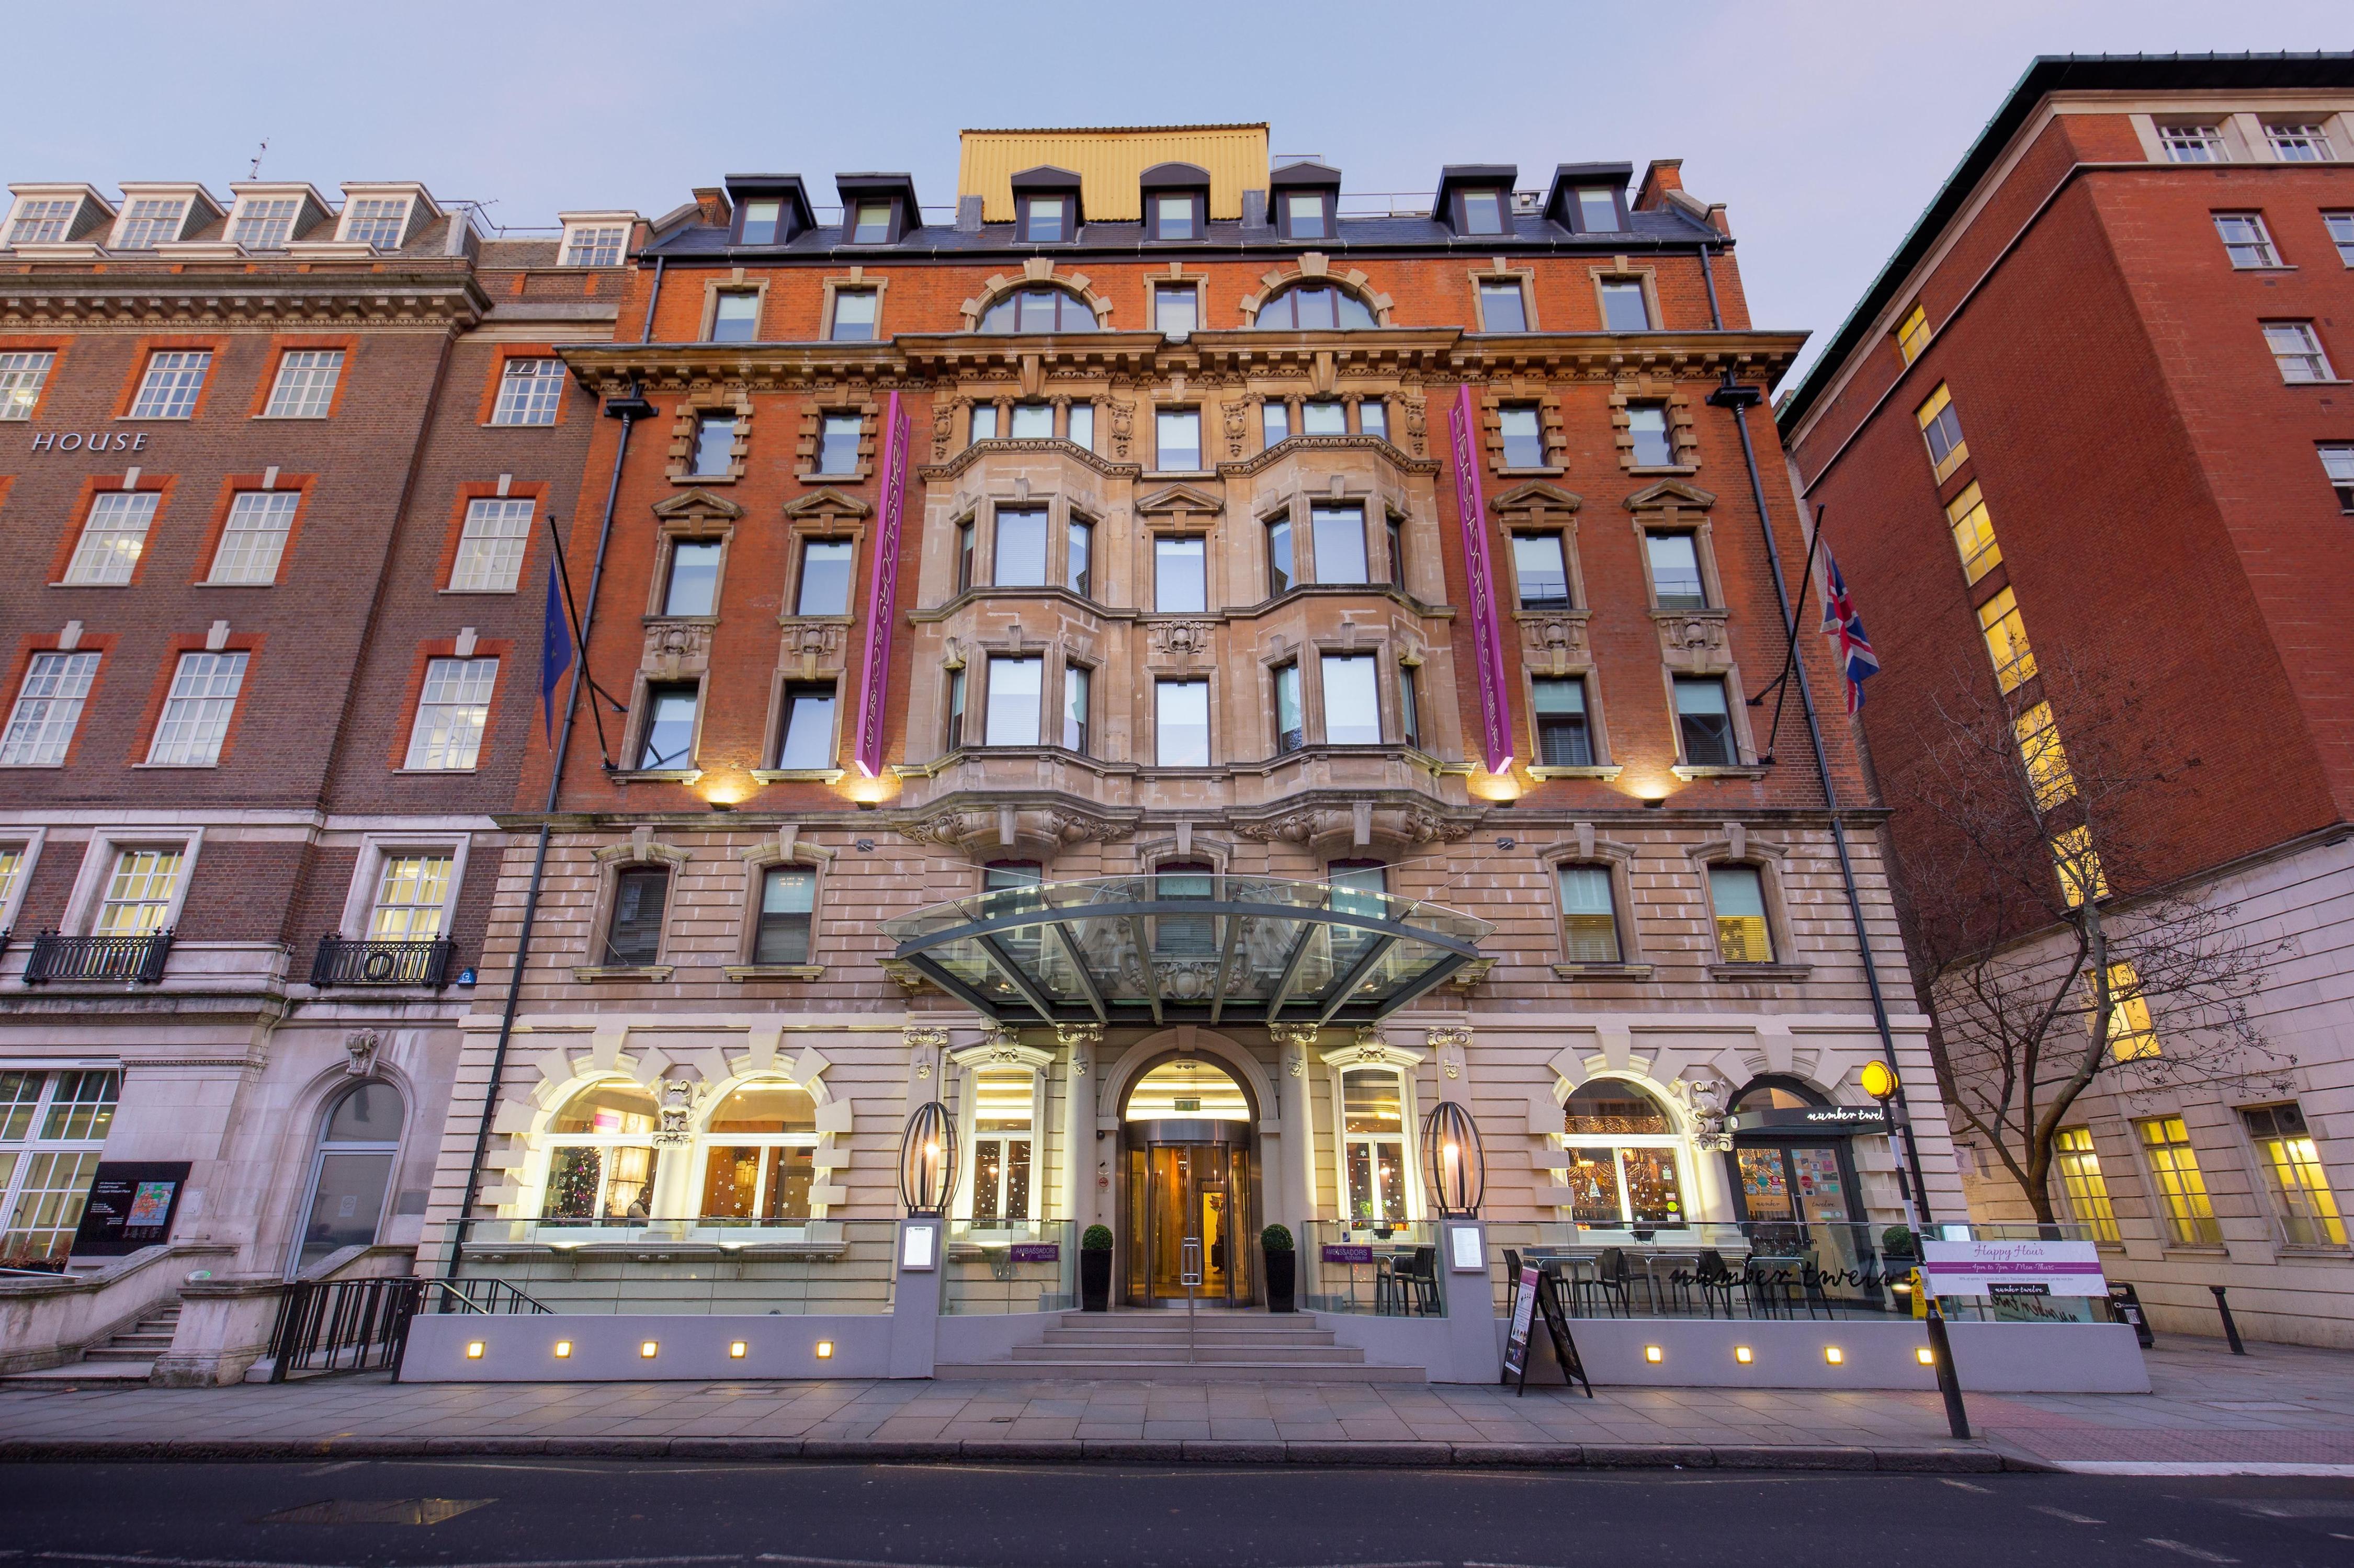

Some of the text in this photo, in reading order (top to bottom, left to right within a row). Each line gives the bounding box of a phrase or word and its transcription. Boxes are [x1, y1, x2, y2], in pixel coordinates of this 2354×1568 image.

[31, 433, 148, 450] HOUSE
[865, 404, 904, 755] AMBASSADORS BLOOMSBURY
[1454, 406, 1500, 752] AMBASSADORS BLOOMSBURY
[1807, 1107, 1894, 1121] number twel
[1974, 1244, 2044, 1260] Happy Hour
[1669, 1253, 1792, 1288] number
[1972, 1264, 1986, 1273] 4pm
[1995, 1264, 2009, 1273] 7pm
[1995, 1285, 2019, 1293] number
